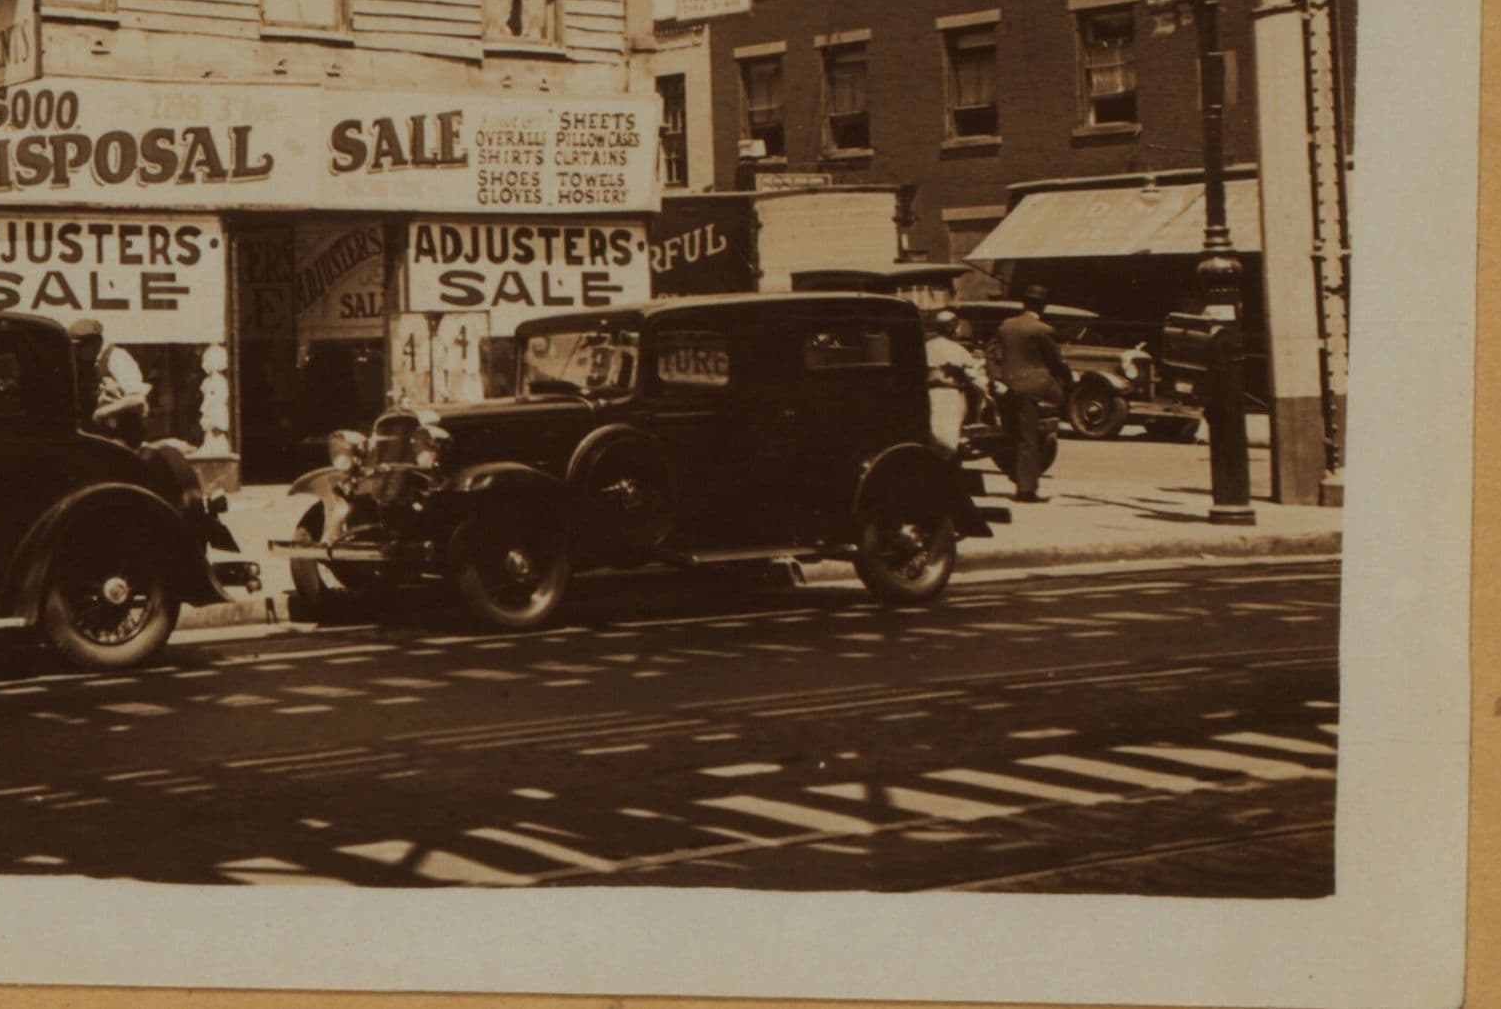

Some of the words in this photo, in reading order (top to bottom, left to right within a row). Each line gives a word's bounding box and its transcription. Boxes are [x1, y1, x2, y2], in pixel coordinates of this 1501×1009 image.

[558, 111, 637, 131] SHEETS
[326, 109, 470, 178] SALE
[474, 129, 547, 149] OVERALLS
[477, 149, 545, 166] SHIRTS
[476, 168, 541, 188] SHOES
[555, 170, 626, 188] TOWELS
[476, 187, 543, 206] GLOVES
[557, 188, 629, 205] HOSIERY
[414, 225, 633, 266] ADJUSTERS
[295, 227, 382, 314] ADJUSTERS
[438, 270, 623, 308] SALE
[339, 291, 383, 320] SAL
